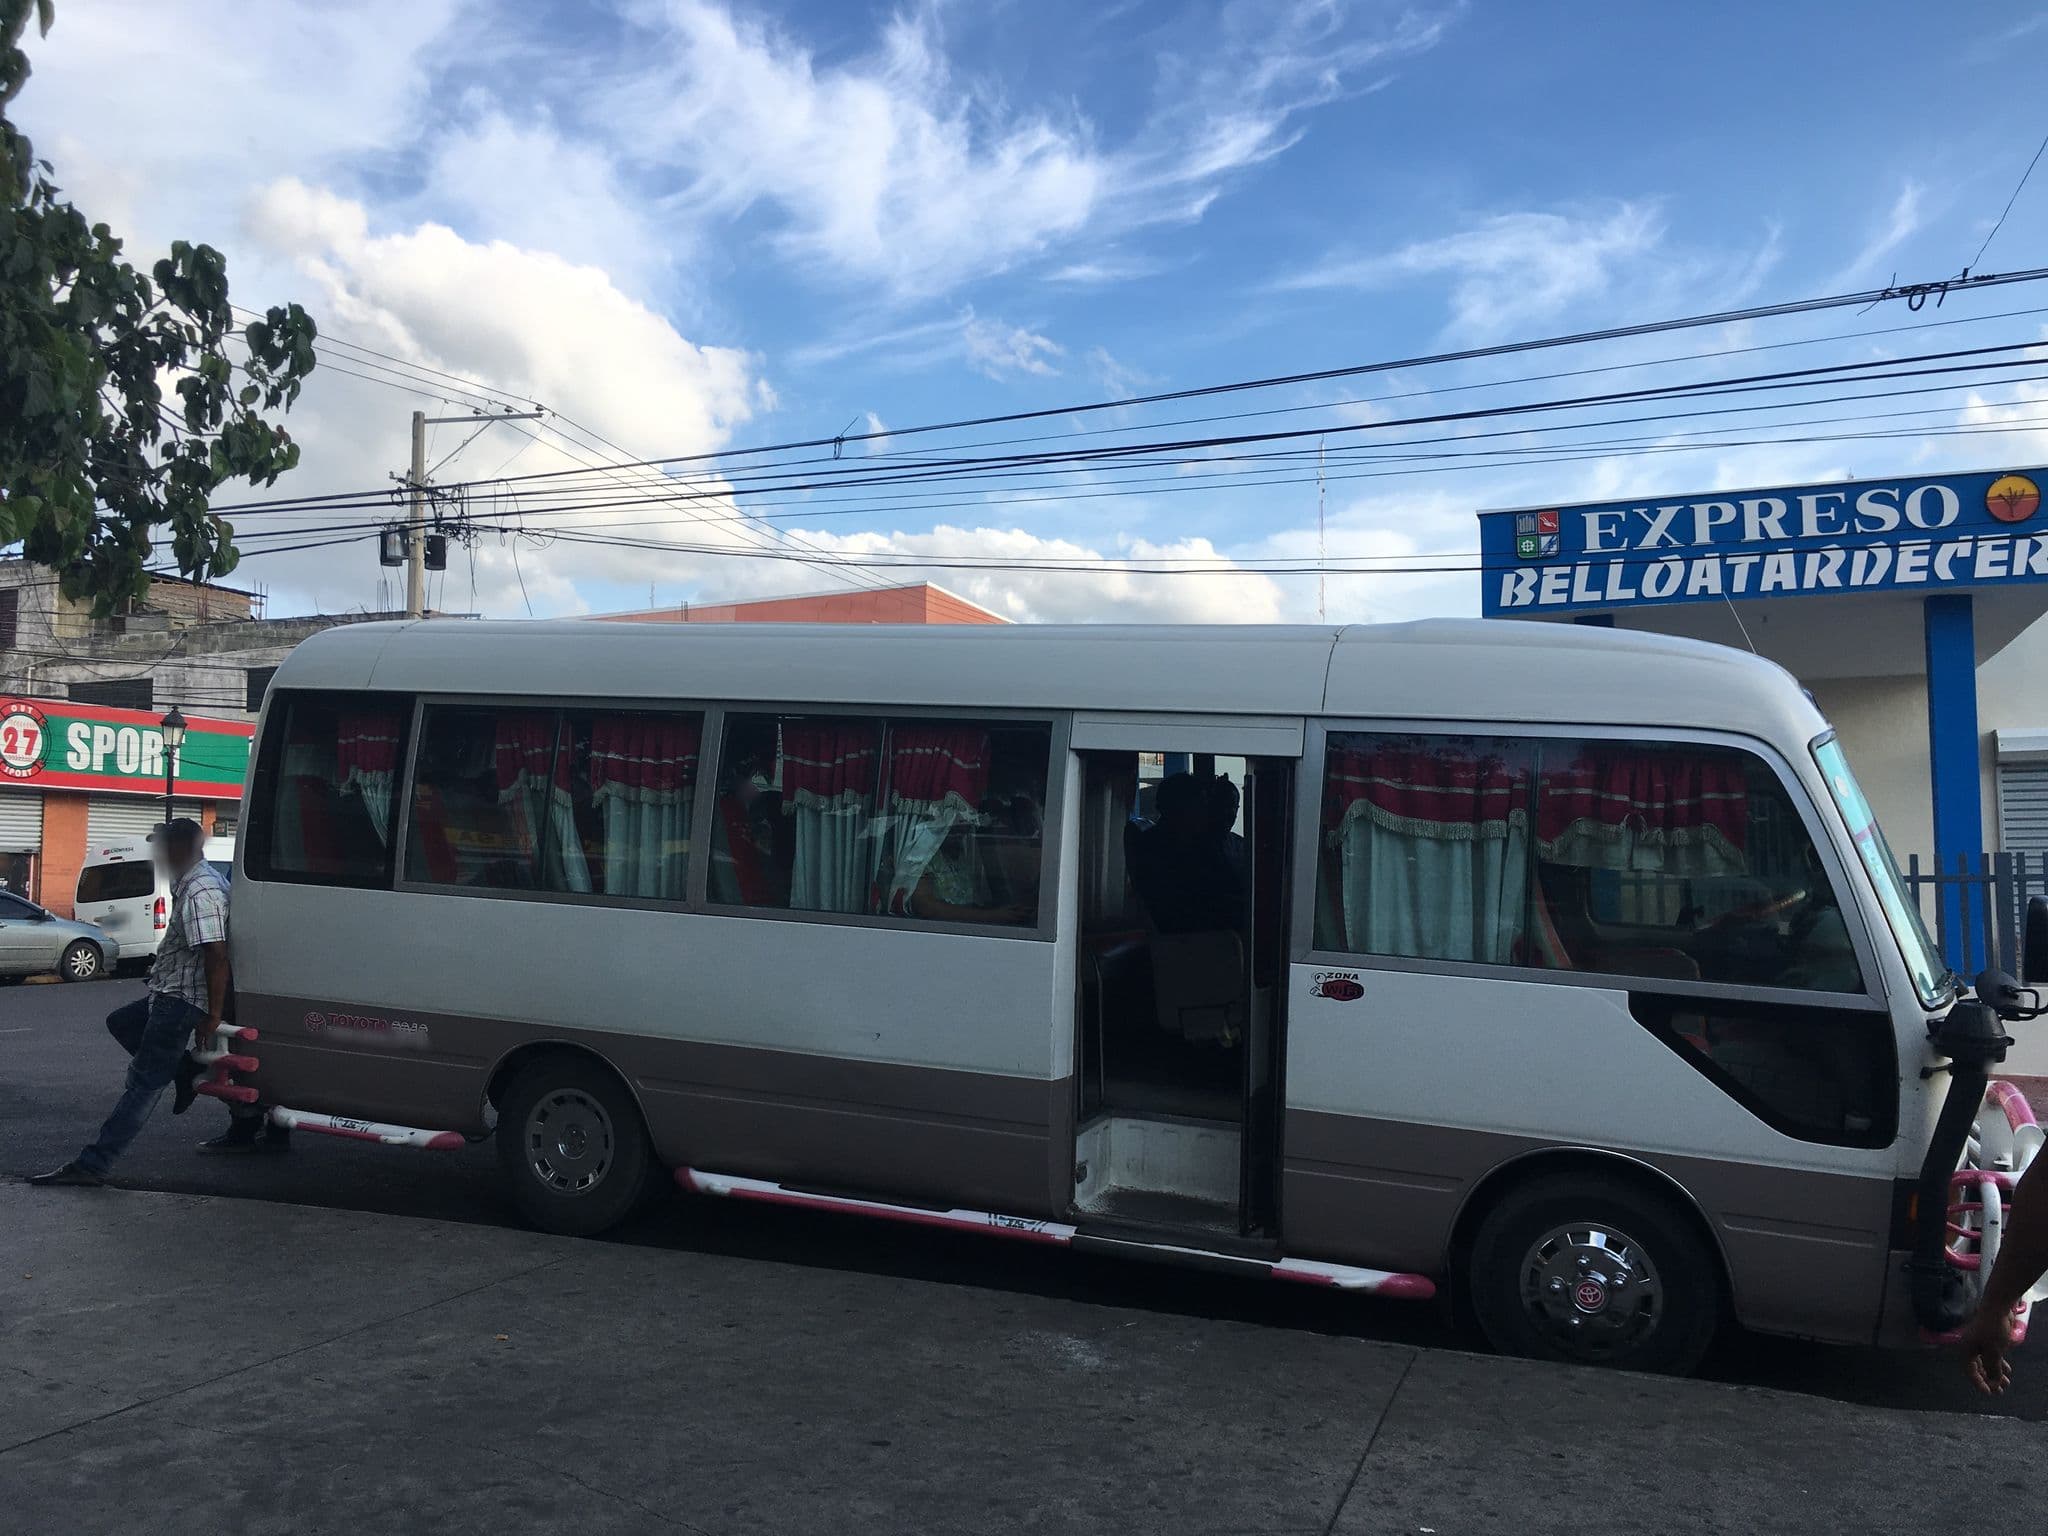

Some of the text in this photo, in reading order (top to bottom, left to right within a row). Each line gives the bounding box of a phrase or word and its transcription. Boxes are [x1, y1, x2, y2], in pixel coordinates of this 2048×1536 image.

[1581, 485, 1960, 554] EXPRESO
[4, 727, 38, 755] 27
[1327, 972, 1360, 980] ZONA
[328, 1012, 389, 1031] TOYOTA
